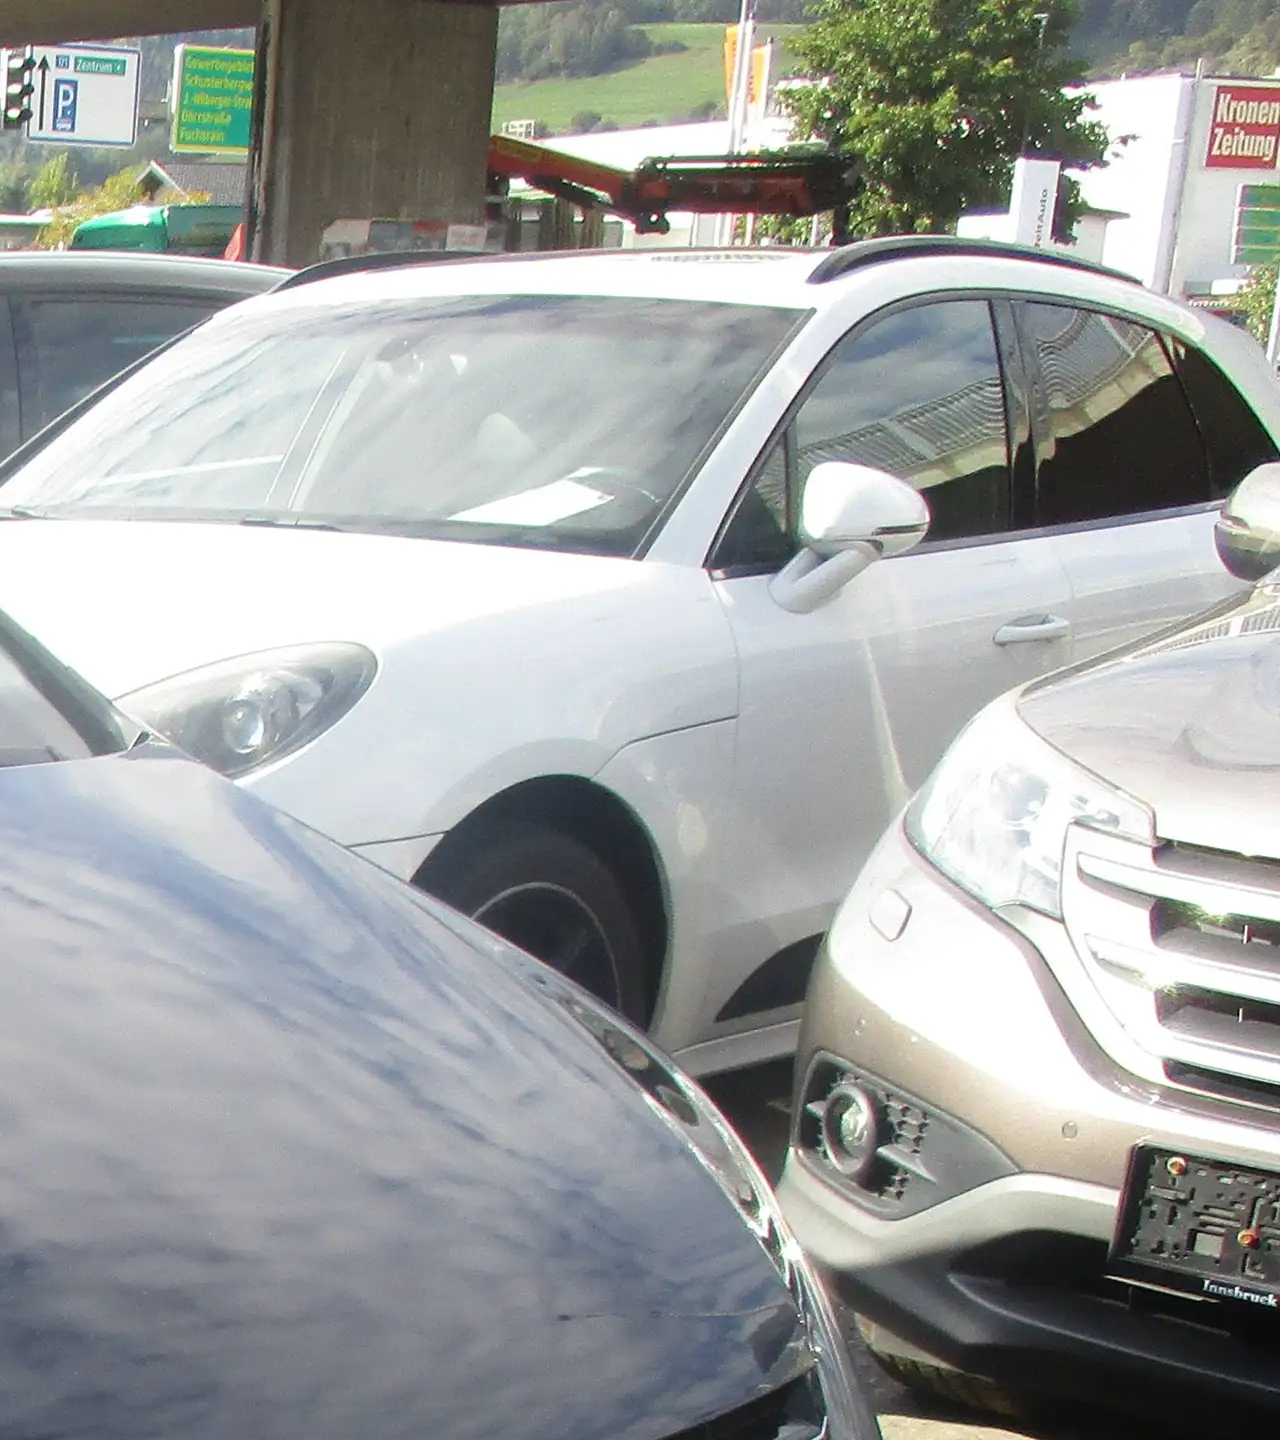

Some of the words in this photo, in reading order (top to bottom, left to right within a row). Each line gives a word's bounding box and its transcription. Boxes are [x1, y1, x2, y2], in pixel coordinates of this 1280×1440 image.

[76, 59, 113, 73] Zentrum
[57, 83, 74, 119] P
[1216, 93, 1280, 125] Kronen
[1211, 126, 1277, 161] Zeitung
[1202, 1279, 1278, 1308] Innsbruck
